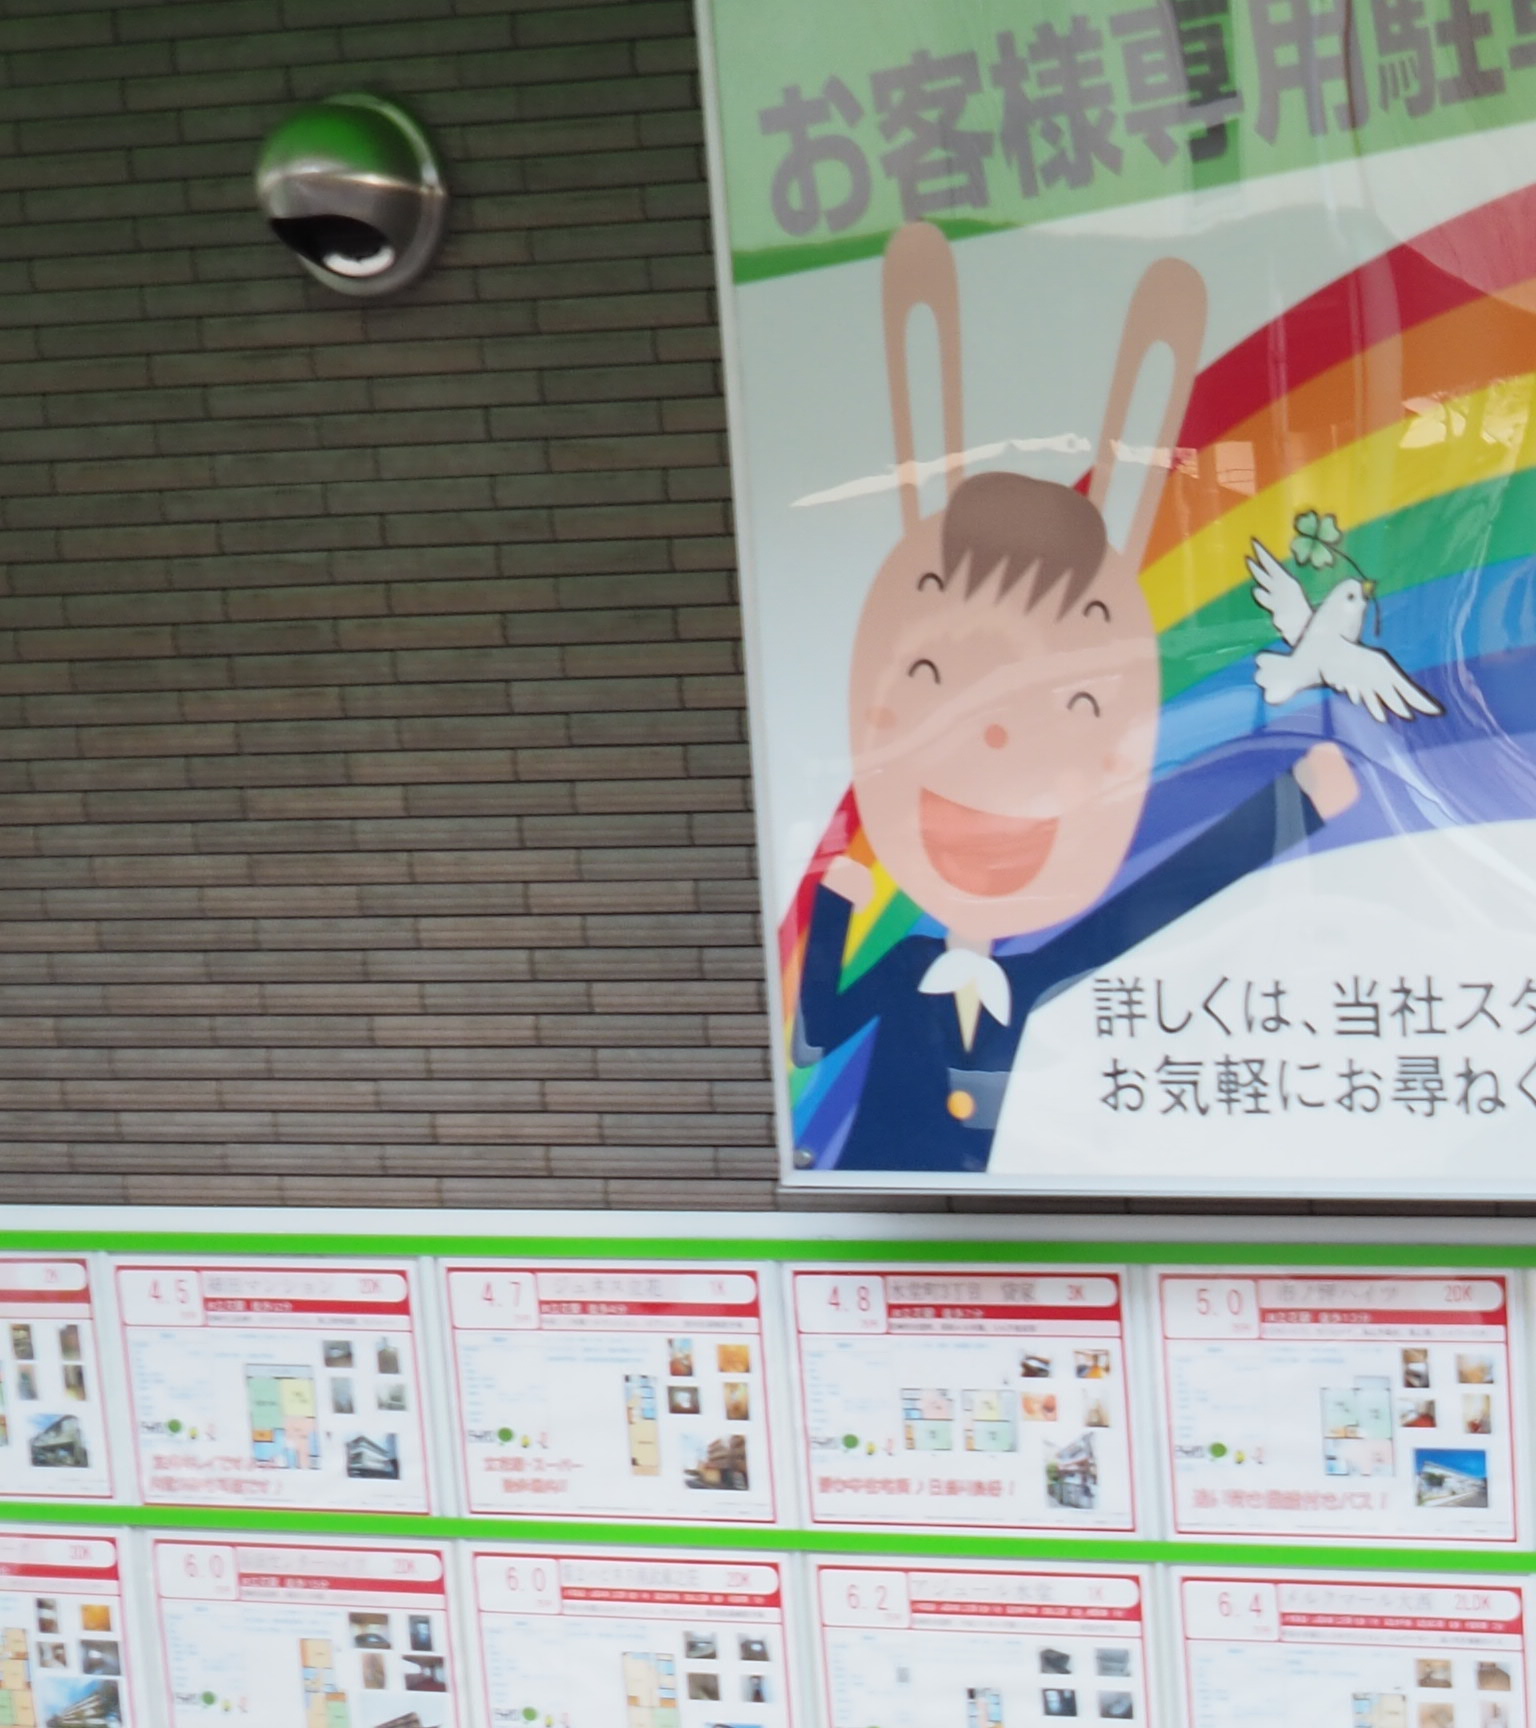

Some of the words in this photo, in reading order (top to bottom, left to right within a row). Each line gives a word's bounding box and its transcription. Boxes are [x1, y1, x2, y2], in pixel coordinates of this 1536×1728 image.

[827, 1285, 872, 1313] 4.8
[1195, 1288, 1245, 1316] 5.0
[846, 1584, 889, 1611] 6.2
[1217, 1591, 1264, 1618] 6.4
